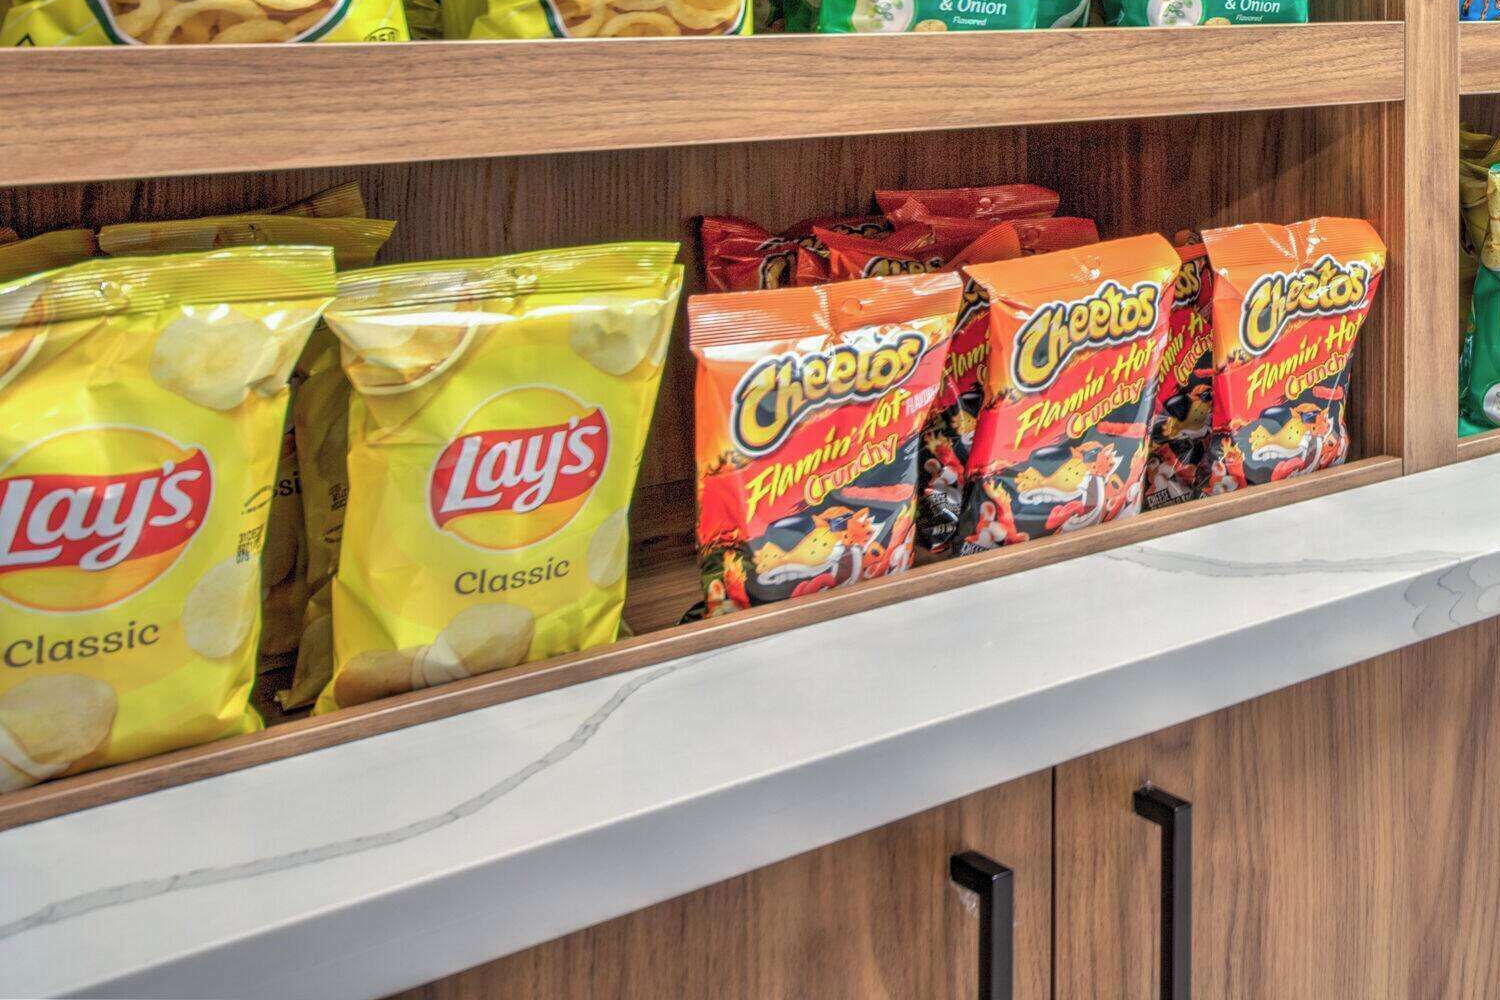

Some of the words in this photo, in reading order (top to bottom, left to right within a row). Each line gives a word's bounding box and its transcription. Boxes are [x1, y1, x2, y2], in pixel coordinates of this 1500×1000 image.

[953, 15, 987, 27] Flavored
[1012, 281, 1161, 391] Cheetos
[1241, 255, 1369, 356] Cheetos
[733, 332, 927, 455] Cheetos
[1110, 337, 1157, 386] Hot
[860, 388, 912, 443] Hot
[1065, 376, 1144, 440] Crunchy
[439, 415, 602, 514] Lay's
[803, 433, 900, 506] Crunchy
[0, 459, 203, 572] Lay's
[454, 556, 571, 597] Classic
[3, 619, 161, 670] Classic
